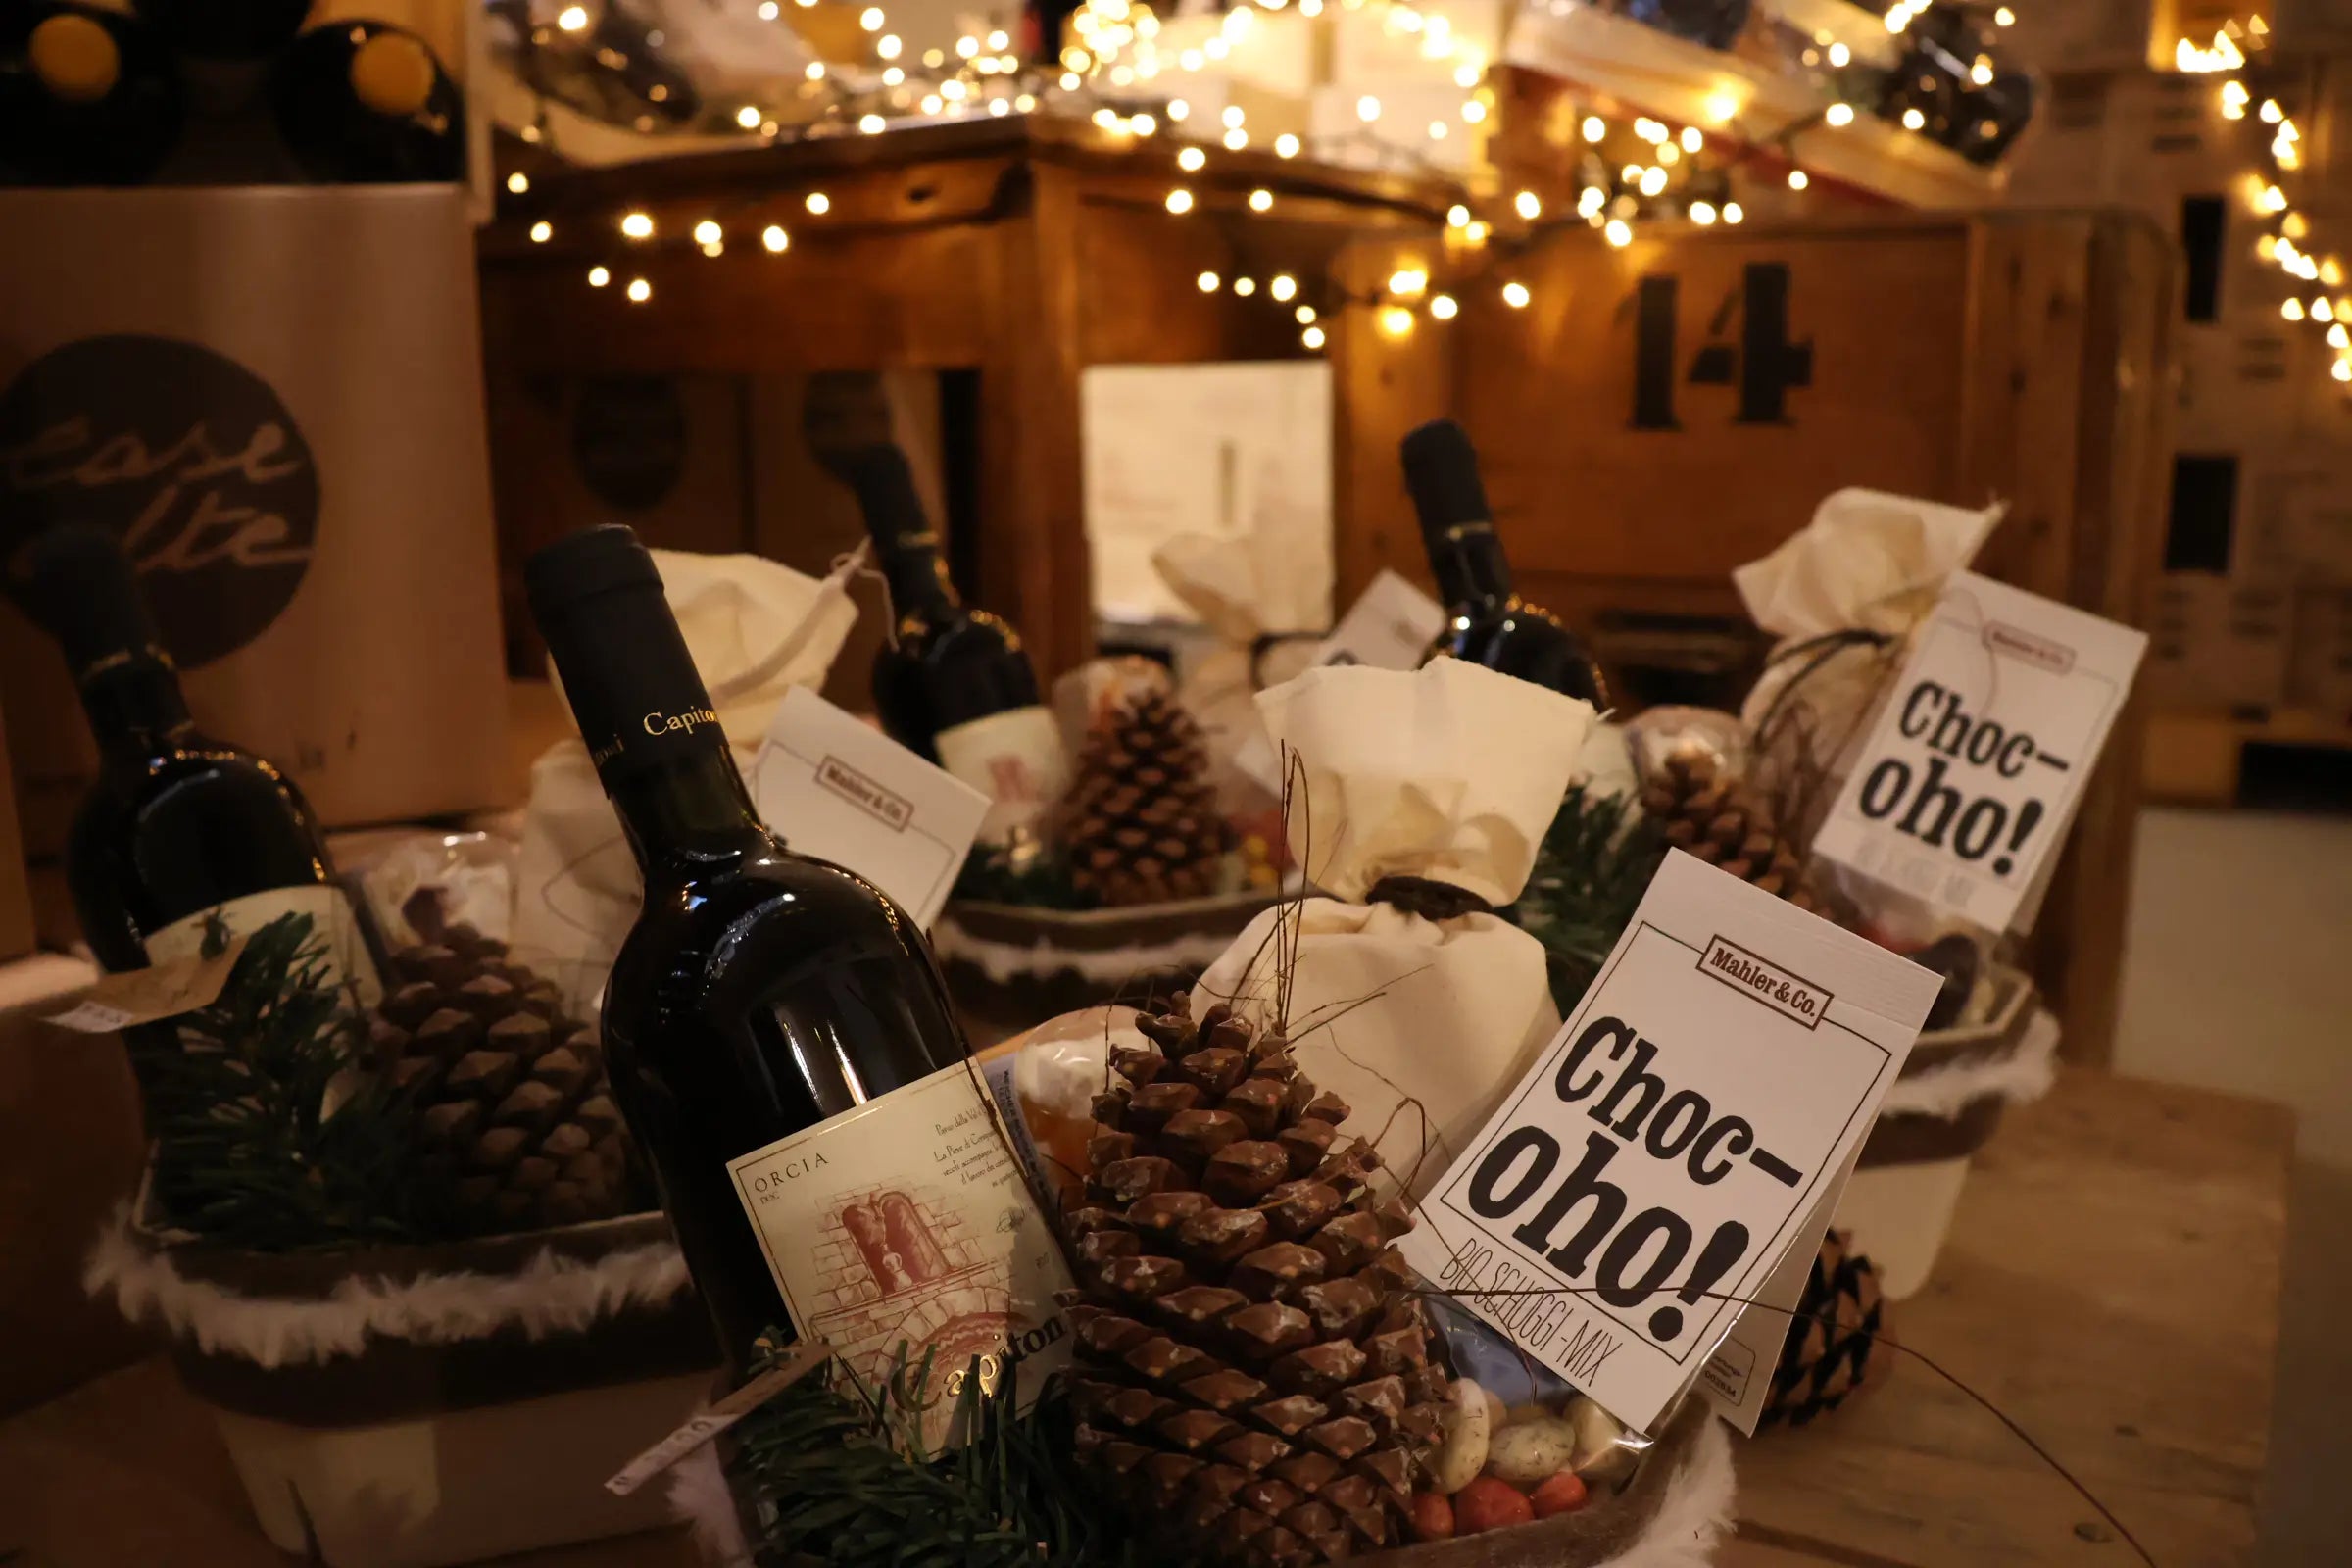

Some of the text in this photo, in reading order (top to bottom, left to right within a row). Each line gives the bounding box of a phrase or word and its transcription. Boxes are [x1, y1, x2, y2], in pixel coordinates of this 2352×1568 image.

[1615, 262, 1813, 430] 14
[1898, 680, 2071, 778] Choc-
[1859, 756, 2045, 876] oho!
[1710, 947, 1777, 994] Mahler
[1554, 1015, 1803, 1188] Choc-
[754, 1152, 829, 1195] ORCIA
[1440, 1237, 1493, 1294] BIO
[1468, 1124, 1750, 1342] oho!
